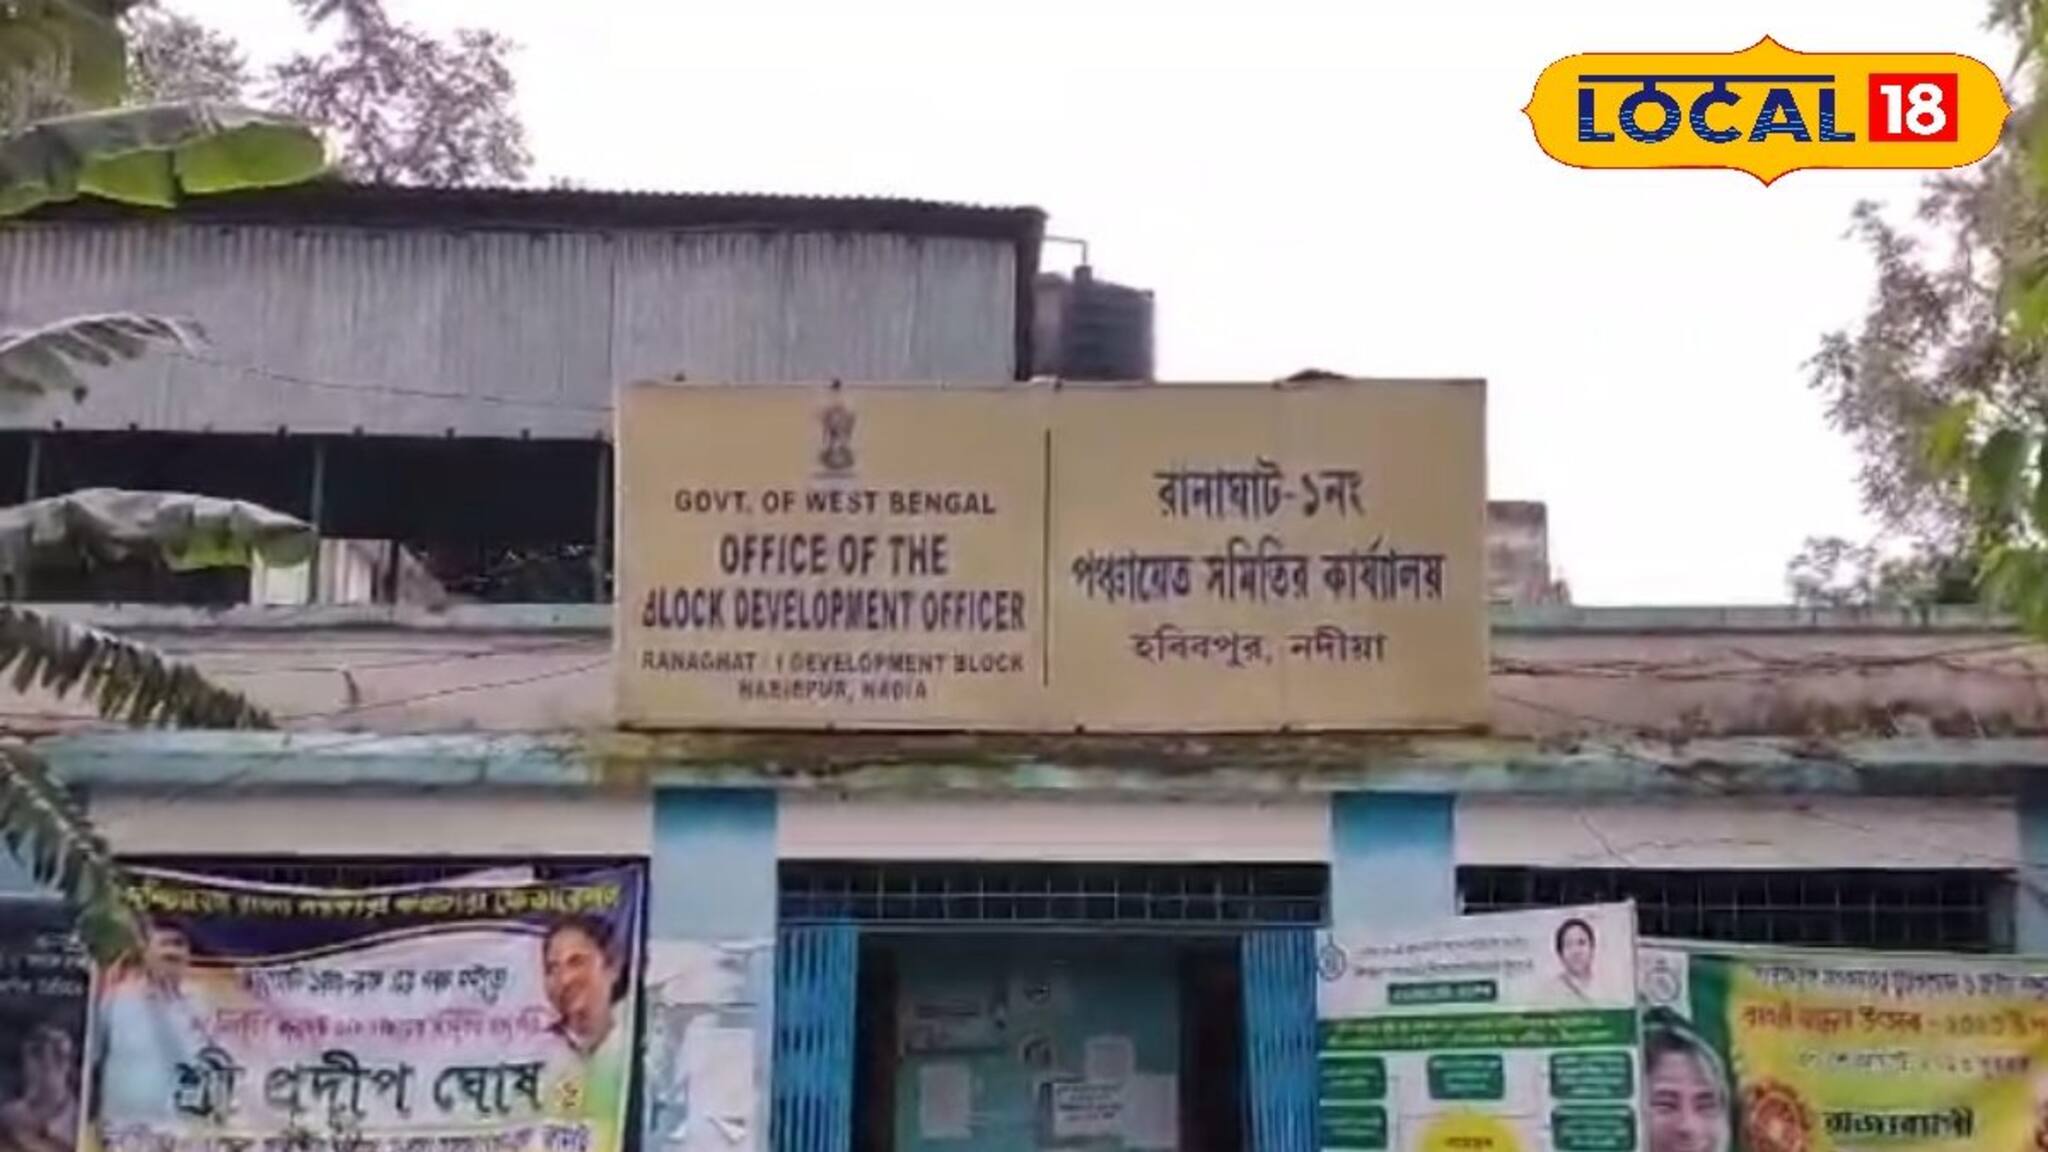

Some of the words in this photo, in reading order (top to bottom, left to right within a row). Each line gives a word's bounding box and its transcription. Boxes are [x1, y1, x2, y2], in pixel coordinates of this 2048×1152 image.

[674, 490, 752, 515] GOVT.
[762, 490, 796, 515] OF
[805, 490, 879, 515] WEST
[889, 491, 996, 515] BENGAL
[719, 534, 827, 576] OFFICE
[838, 534, 880, 576] OF
[888, 534, 949, 576] THE
[1201, 536, 1309, 602] সমিতির
[734, 590, 914, 631] DEVELOPMENT
[923, 590, 1026, 632] OFFICER
[789, 652, 944, 673] DEVELOPMENT
[953, 652, 1024, 673] BLOCK
[434, 1061, 546, 1114] ঘোষ
